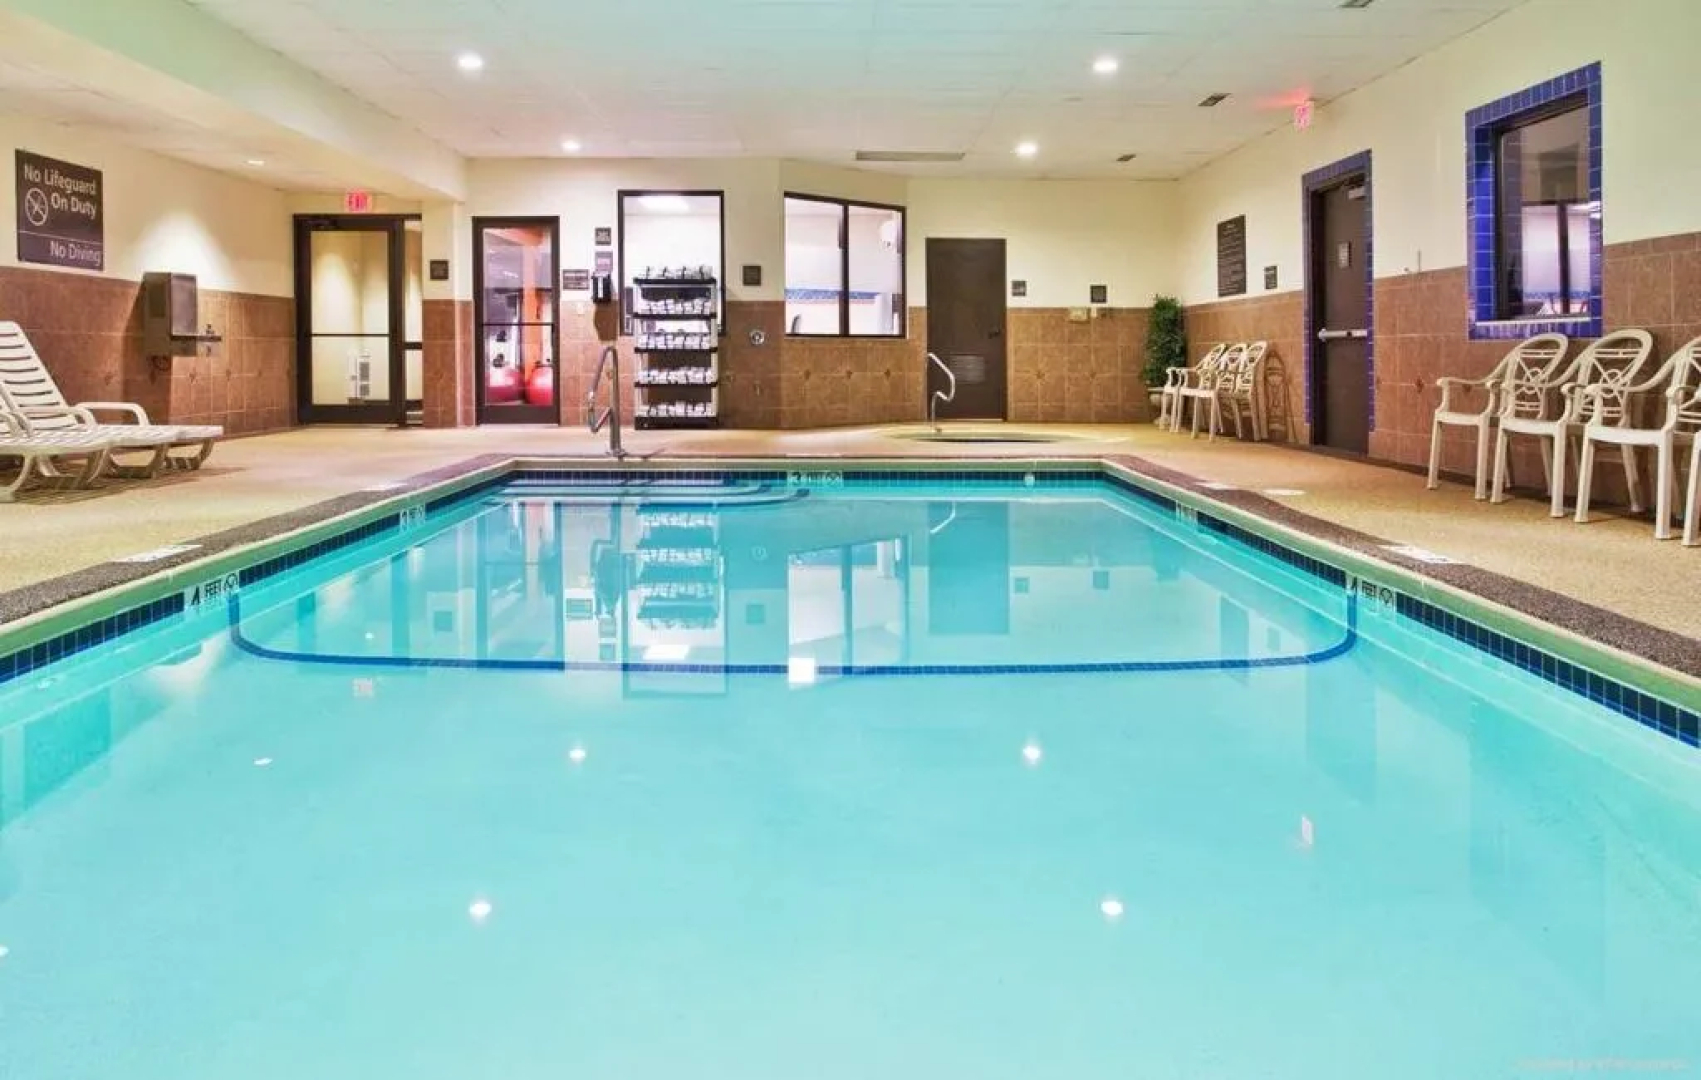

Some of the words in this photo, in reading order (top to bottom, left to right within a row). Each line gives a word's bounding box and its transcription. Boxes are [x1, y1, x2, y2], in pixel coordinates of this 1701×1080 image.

[24, 163, 41, 182] No
[45, 168, 96, 194] Lifeguard
[51, 192, 68, 211] On
[71, 197, 97, 219] Duty
[50, 240, 66, 258] No
[68, 243, 101, 266] Diving
